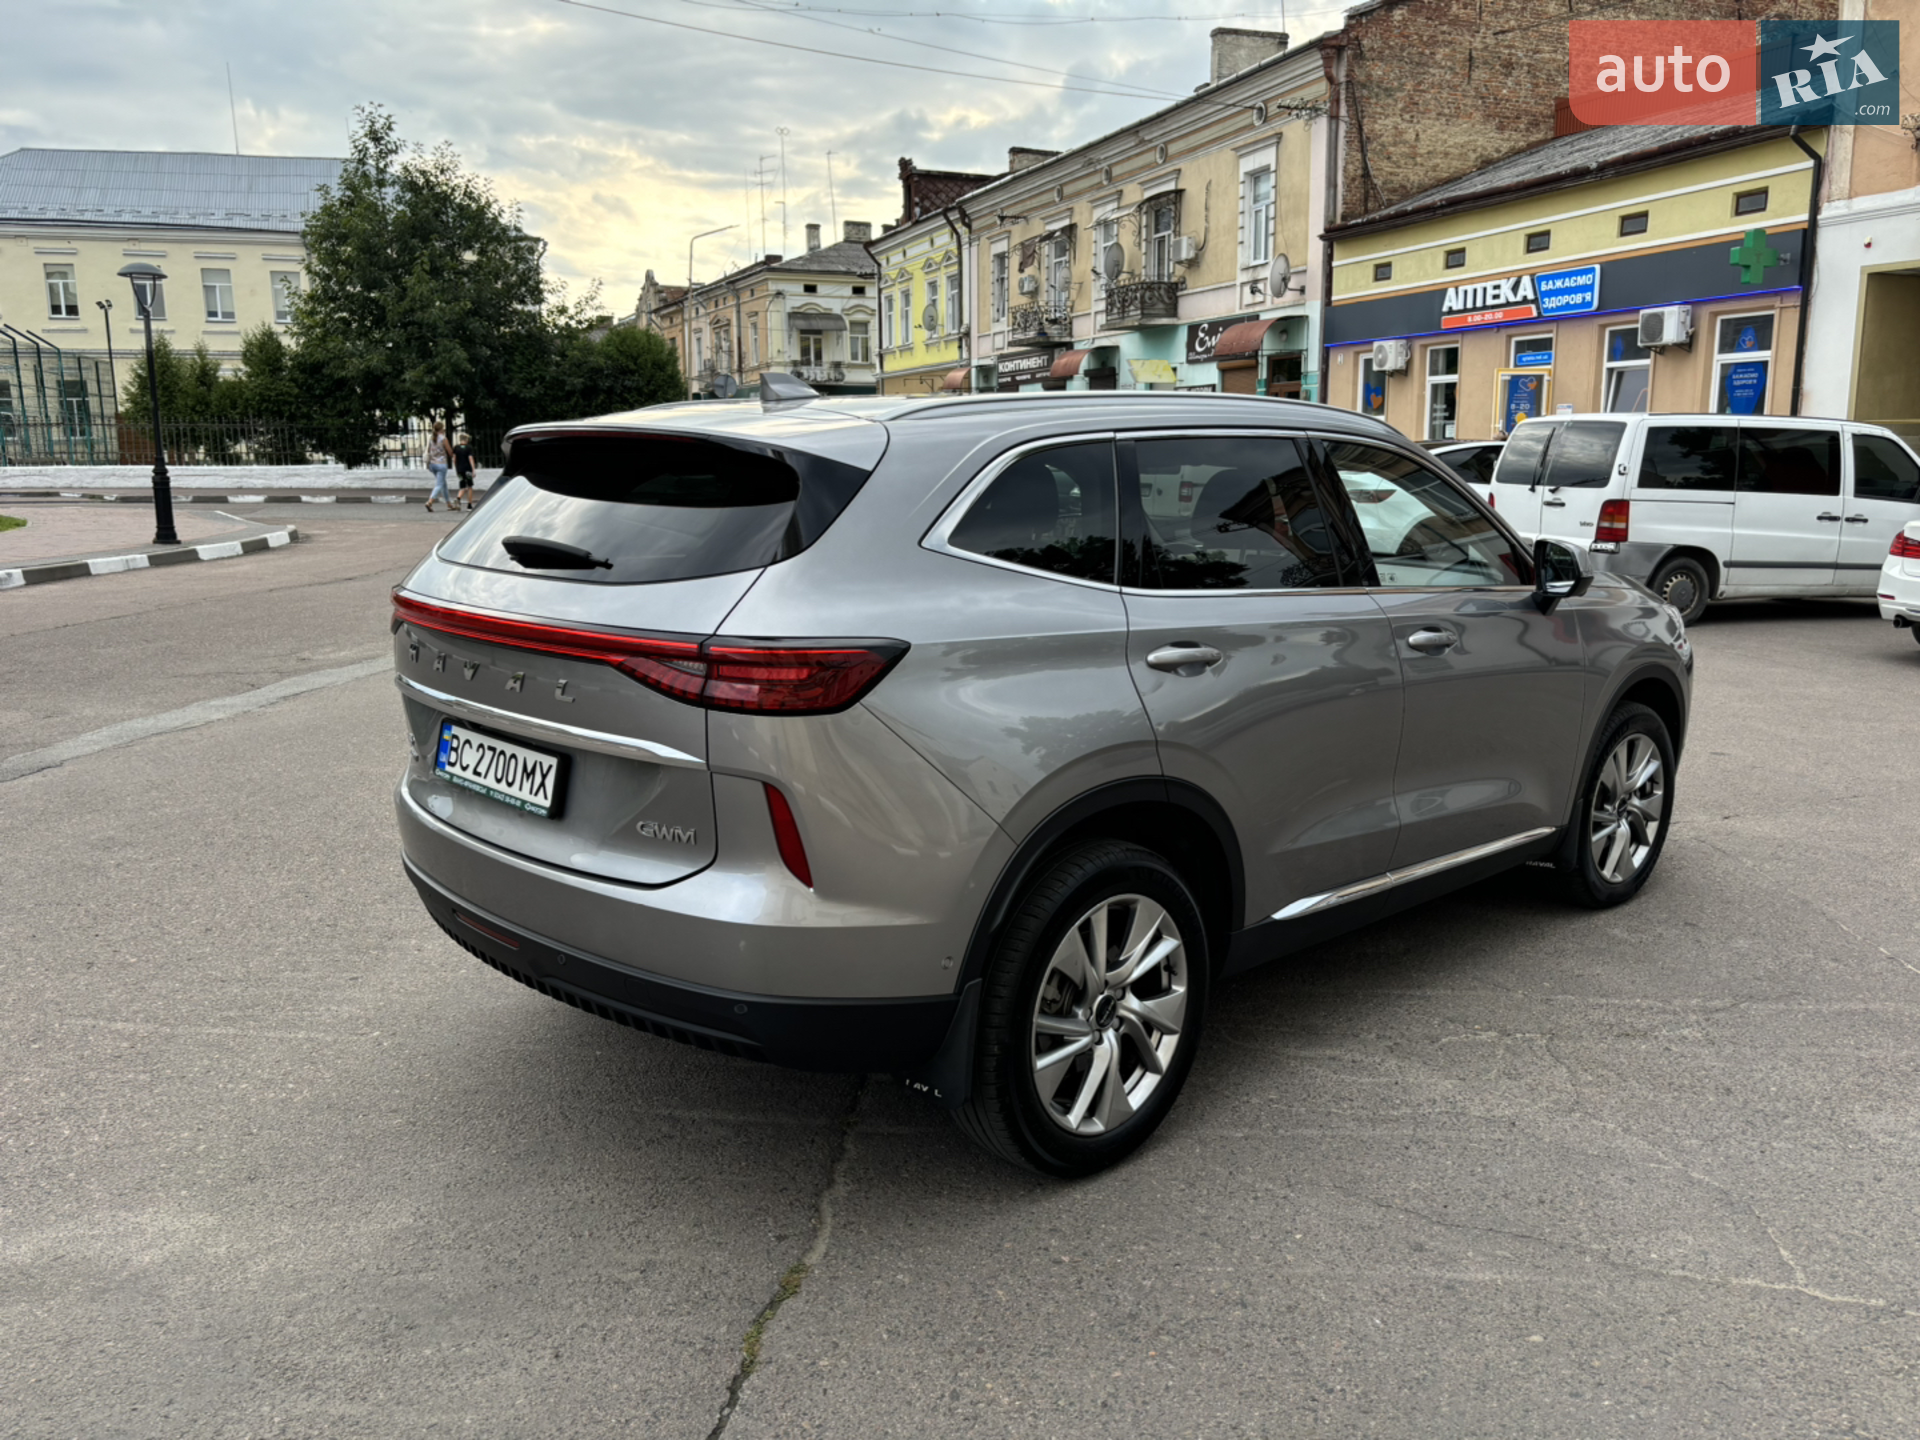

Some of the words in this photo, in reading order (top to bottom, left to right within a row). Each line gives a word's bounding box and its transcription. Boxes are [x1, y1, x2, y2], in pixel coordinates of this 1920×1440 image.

[1442, 275, 1537, 312] АПТЕКА
[1540, 274, 1594, 291] БАЖАЄМО
[1542, 292, 1592, 309] ЗДОРОВ'Я
[998, 355, 1049, 373] КОНТИНЕНТ
[408, 642, 576, 703] HAVAL
[636, 820, 697, 846] GWM
